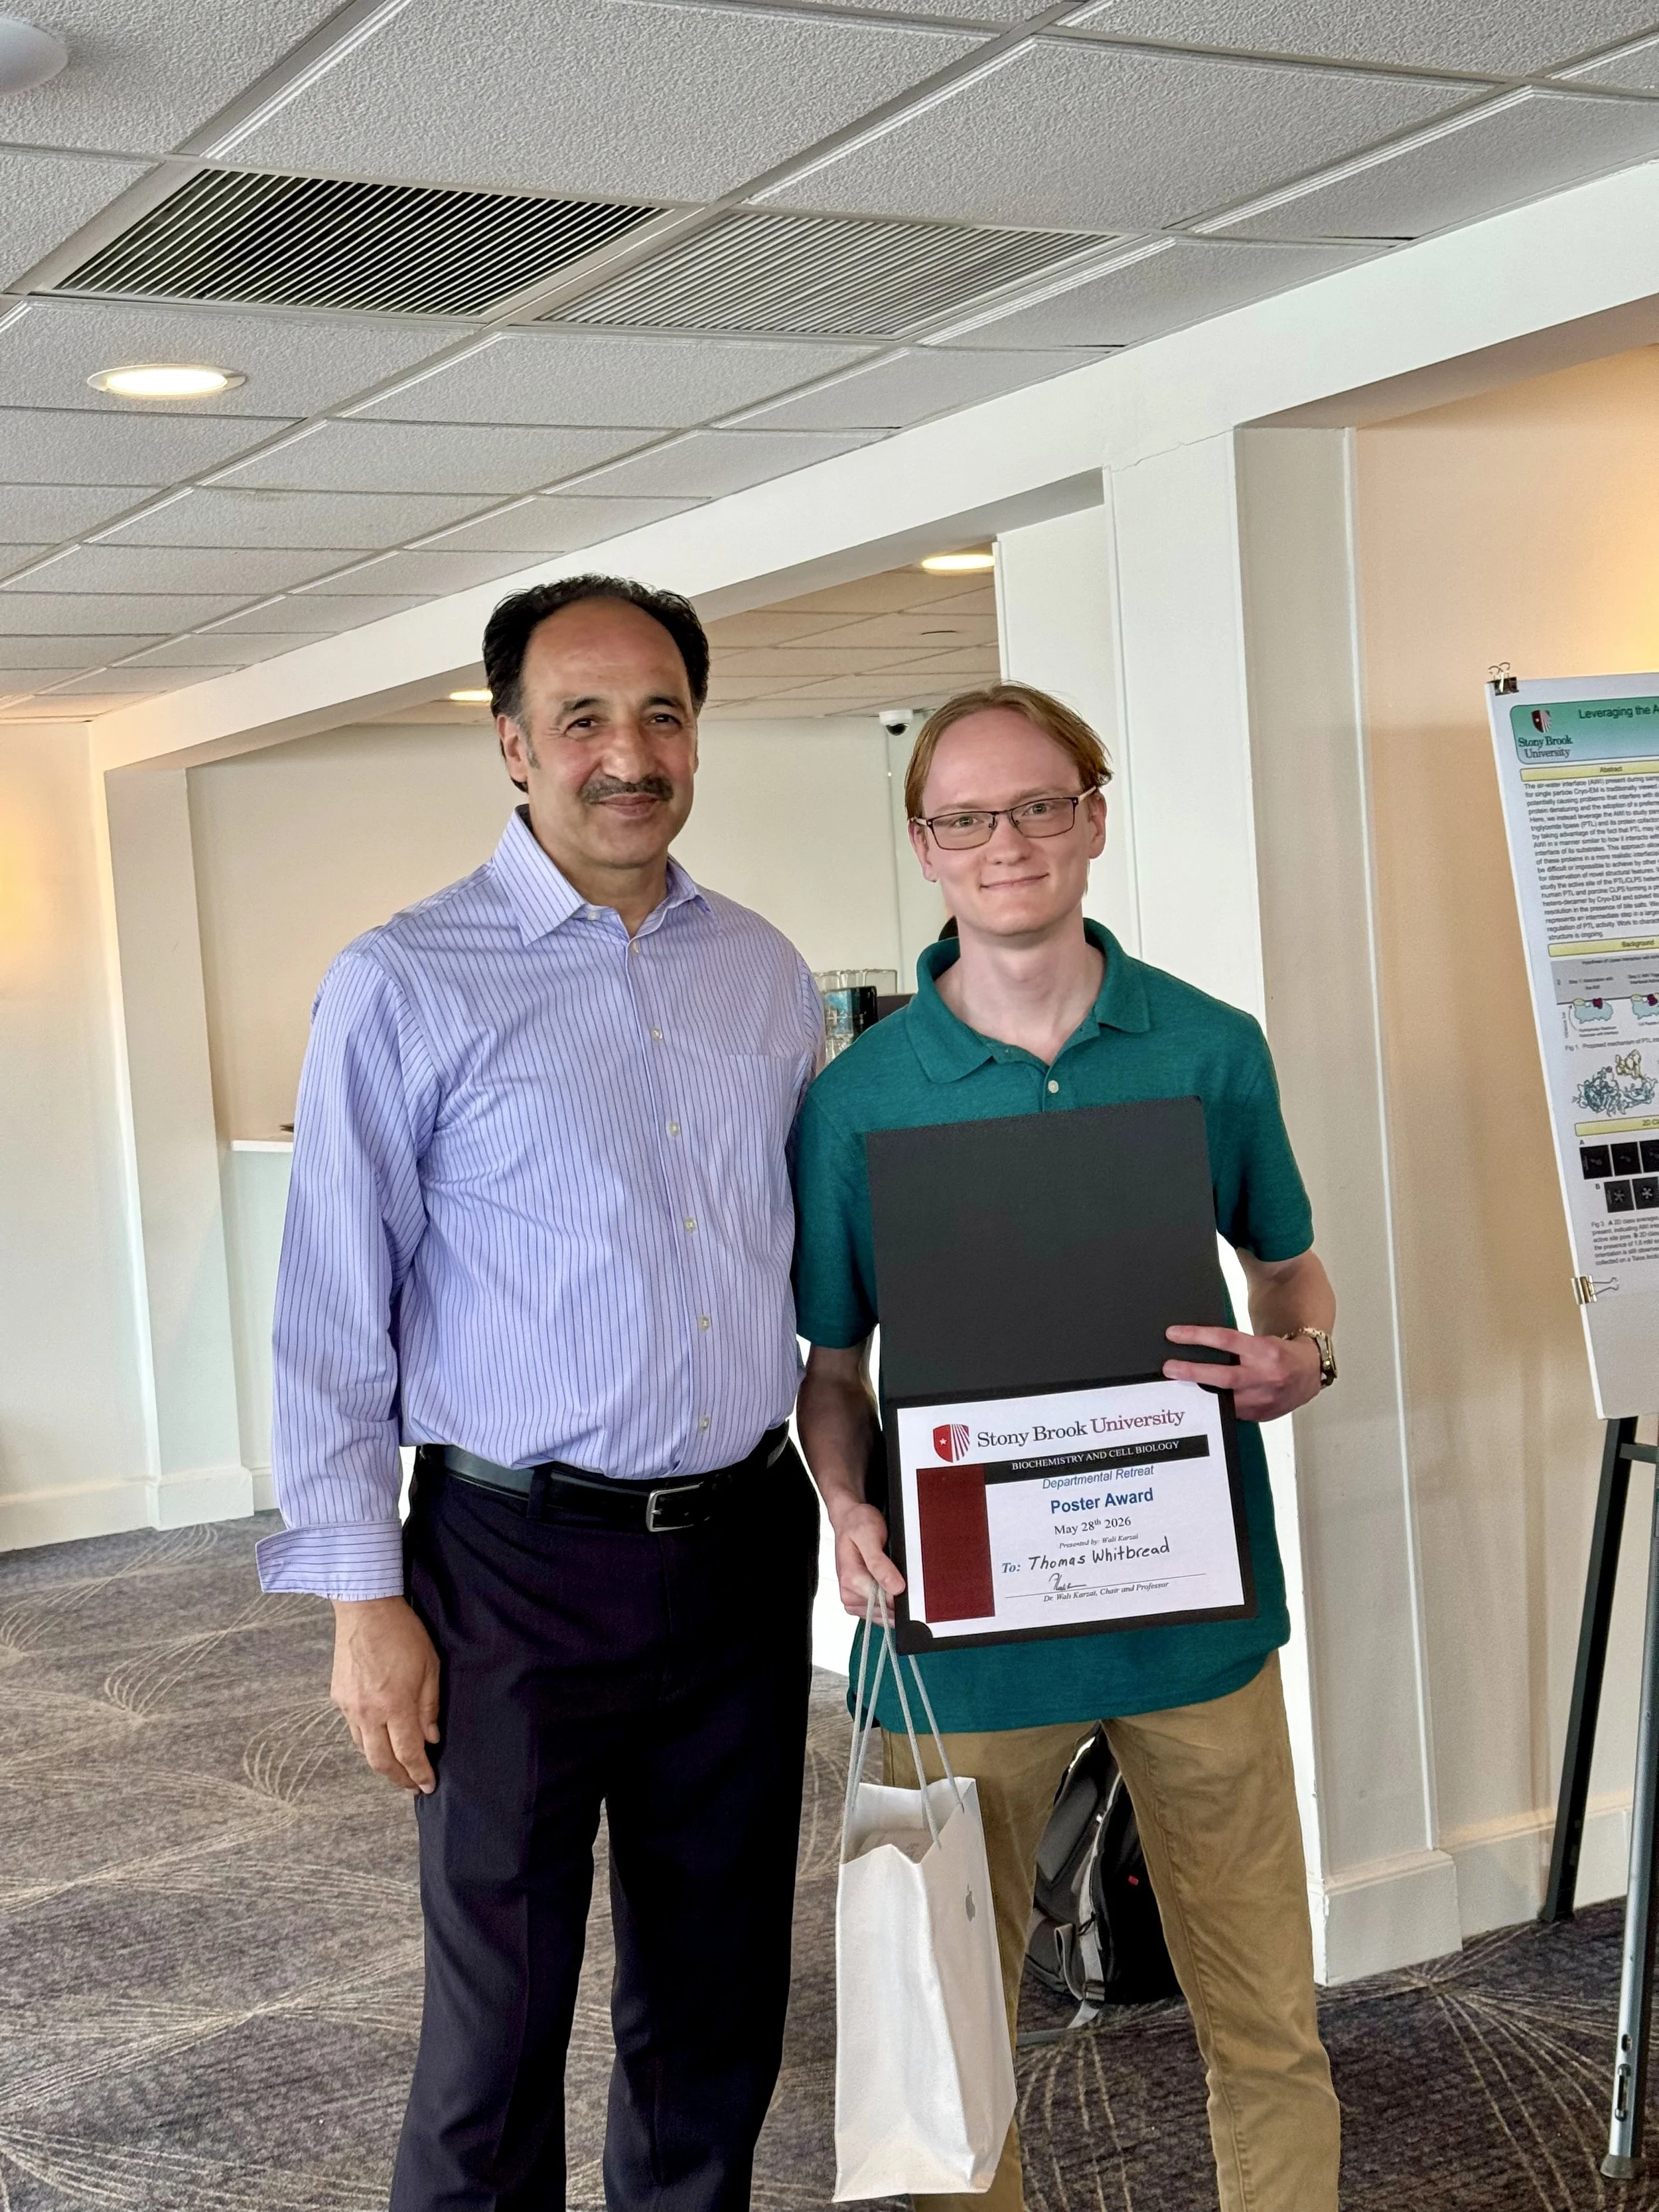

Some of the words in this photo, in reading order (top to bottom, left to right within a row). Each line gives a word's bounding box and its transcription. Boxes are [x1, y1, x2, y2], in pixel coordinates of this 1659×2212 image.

[1578, 706, 1633, 719] Leveraging
[1635, 705, 1651, 715] the
[1518, 737, 1544, 749] Stony
[1546, 735, 1573, 746] Brook
[1524, 748, 1570, 759] University
[1622, 939, 1655, 948] Background
[977, 1432, 1029, 1447] Stony
[1032, 1421, 1088, 1441] Brook
[1090, 1409, 1185, 1434] University
[1012, 1454, 1085, 1471] BIOCHEMISTRY
[1086, 1450, 1107, 1461] AND
[1109, 1447, 1134, 1458] CELL
[1135, 1440, 1180, 1455] BIOLOGY
[1042, 1470, 1113, 1490] Departmental
[1116, 1465, 1154, 1480] Retreat
[1050, 1497, 1100, 1514] Poster
[1104, 1487, 1154, 1508] Award
[1054, 1524, 1078, 1535] May
[1081, 1518, 1101, 1532] 28th
[1104, 1516, 1131, 1529] 2026
[1059, 1539, 1089, 1549] Presented
[1029, 1554, 1086, 1571] Thomas
[1092, 1536, 1170, 1563] Whitbread
[1002, 1562, 1021, 1573] To:
[1136, 1582, 1169, 1591] Professor
